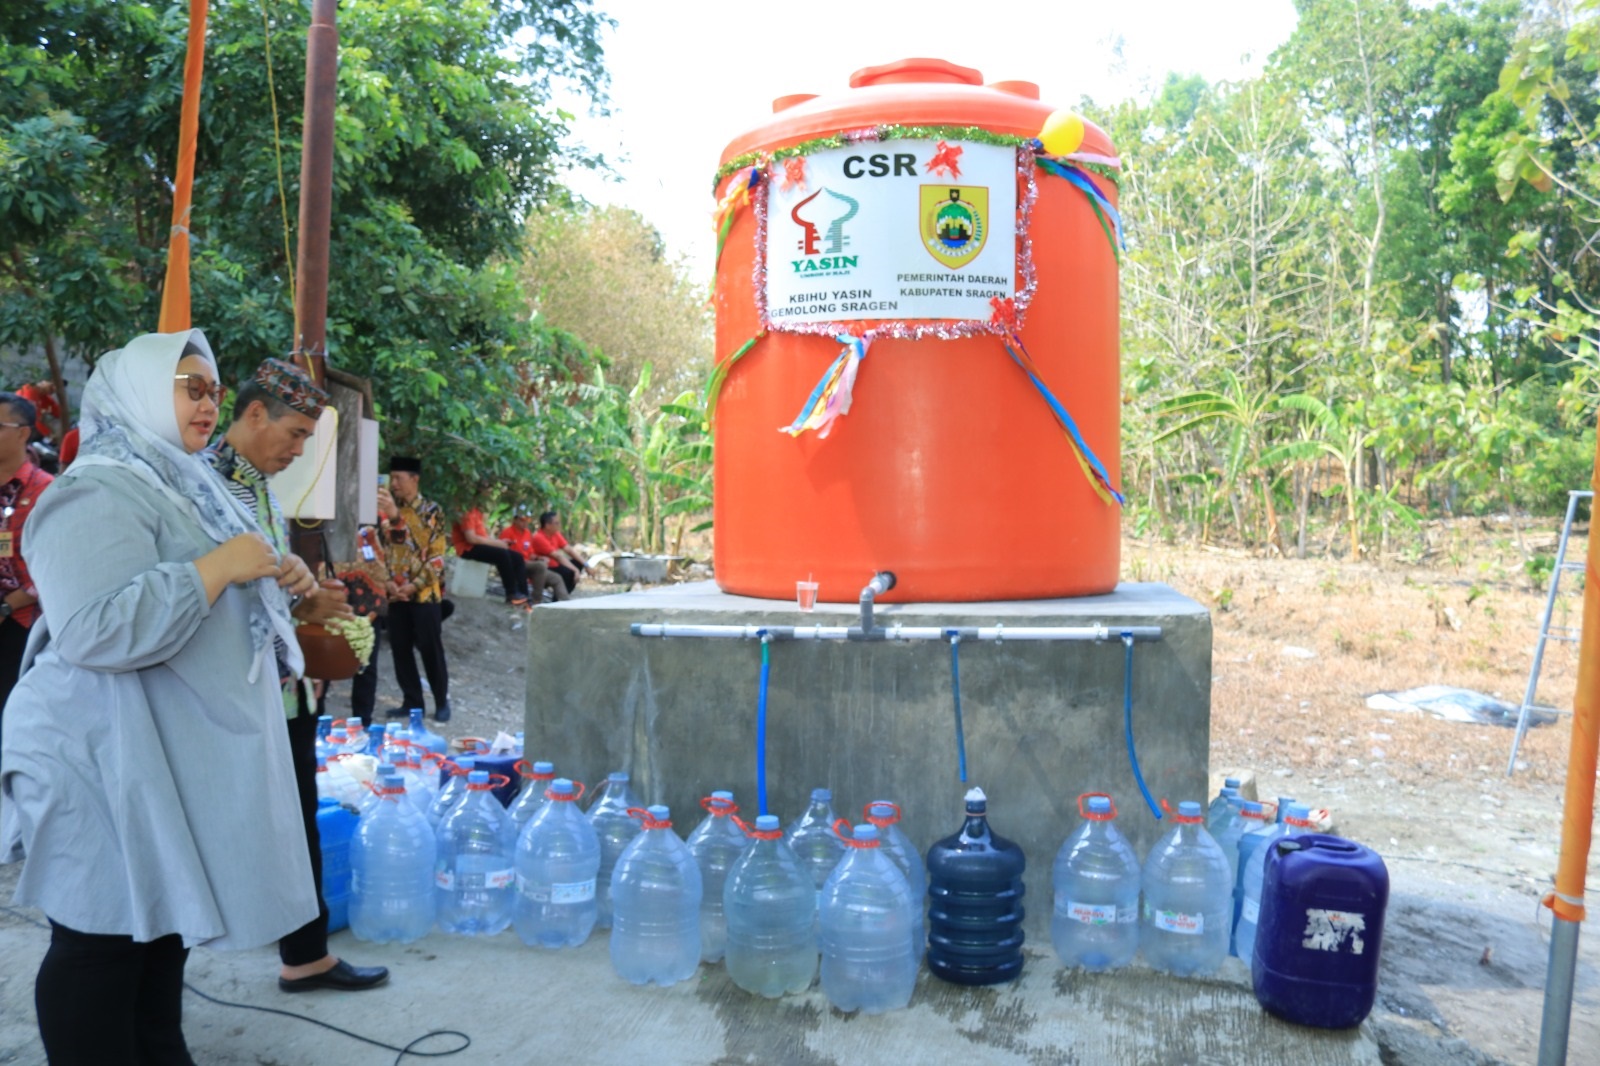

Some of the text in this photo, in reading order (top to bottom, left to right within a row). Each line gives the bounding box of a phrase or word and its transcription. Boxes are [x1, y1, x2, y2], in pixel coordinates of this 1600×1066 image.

[843, 153, 918, 179] CSR
[791, 255, 859, 273] YASIN
[897, 273, 1008, 285] PEMERINTAH DAERAH
[789, 289, 872, 304] KBIHU YASIN
[900, 288, 1006, 299] KABUPATEN SRAGEN
[770, 301, 898, 318] GEMOLONG SRAGEN
